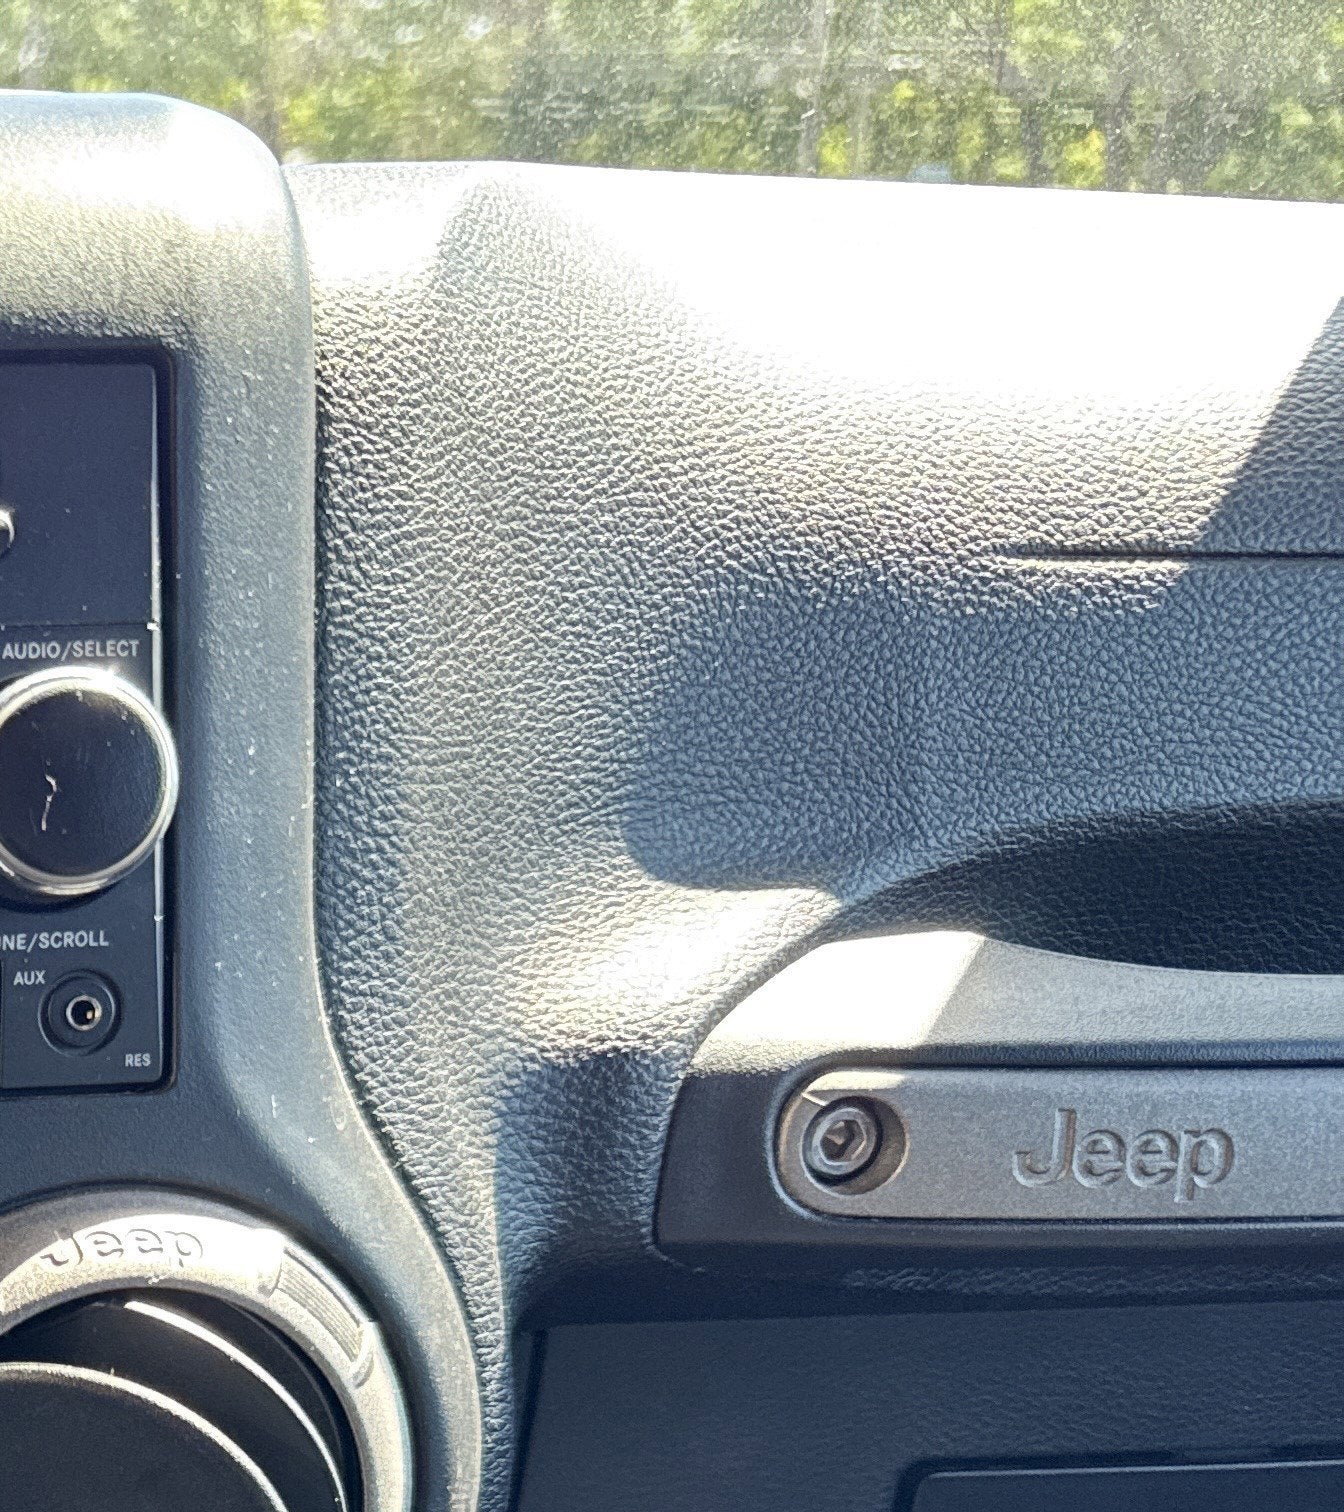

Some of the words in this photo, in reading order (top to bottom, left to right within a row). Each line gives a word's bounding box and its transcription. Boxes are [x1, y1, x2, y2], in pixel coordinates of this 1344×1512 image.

[1, 638, 140, 661] AUDIO/SELECT
[13, 970, 46, 987] AUX
[124, 1053, 151, 1068] RES
[1011, 1107, 1235, 1203] Jeep
[39, 1228, 203, 1268] Jeep
